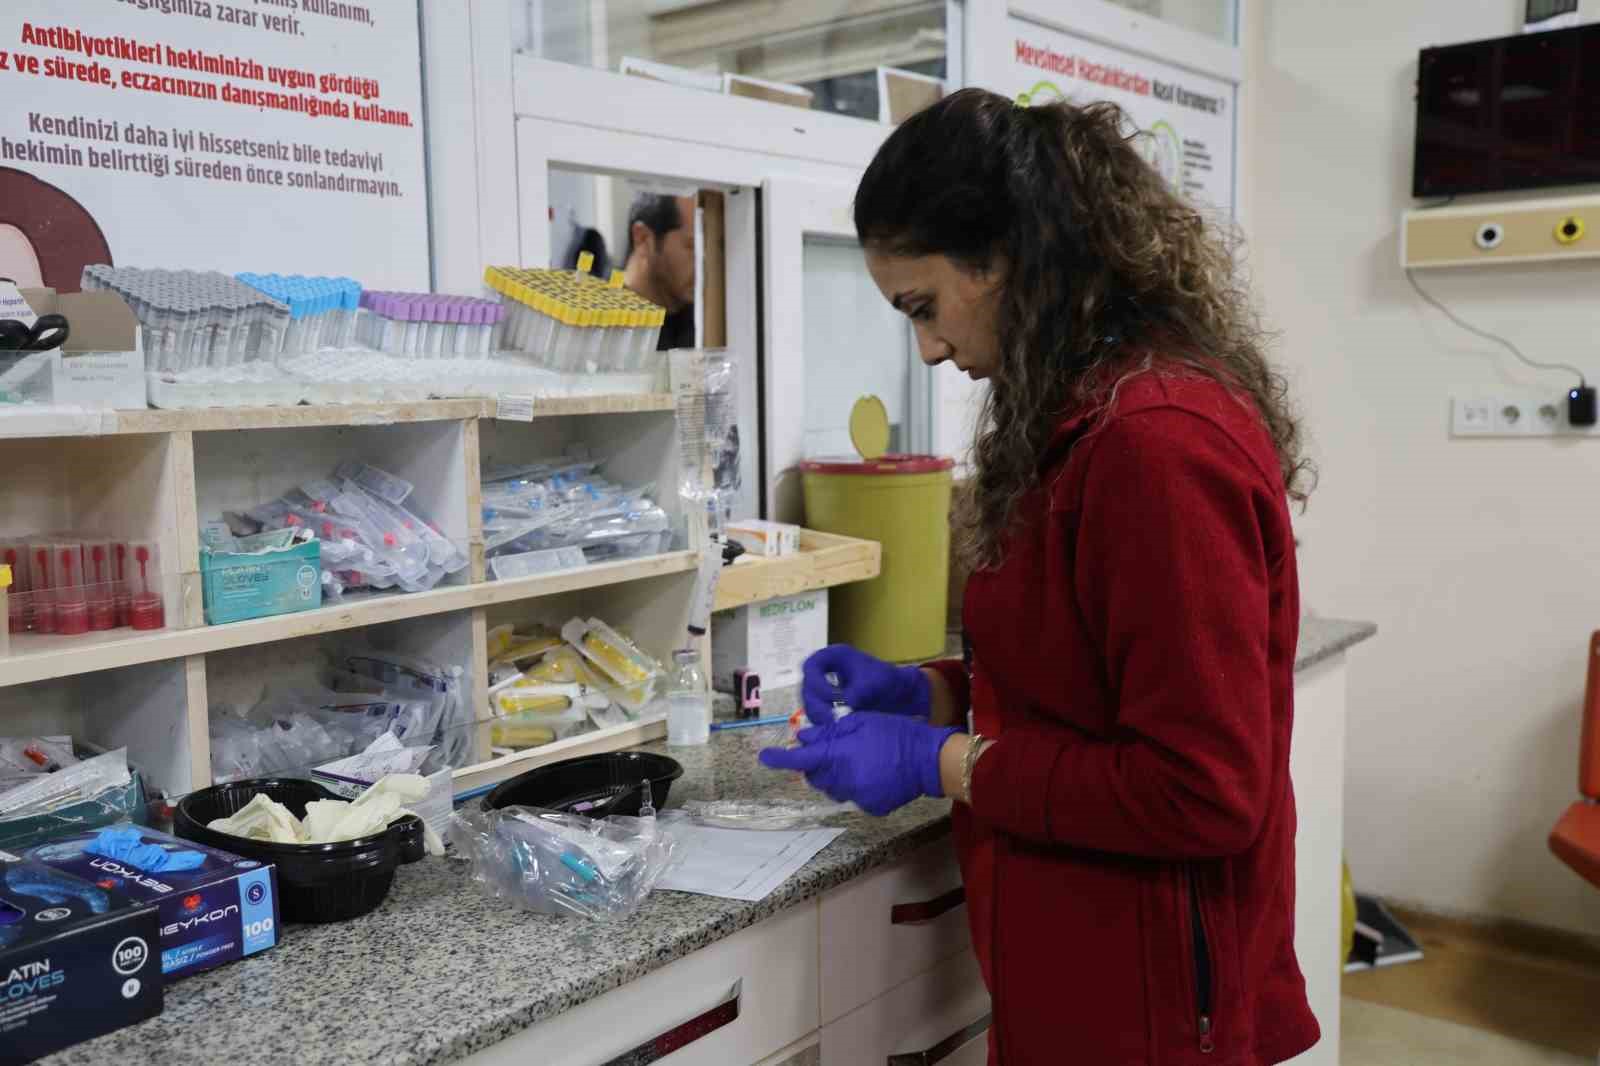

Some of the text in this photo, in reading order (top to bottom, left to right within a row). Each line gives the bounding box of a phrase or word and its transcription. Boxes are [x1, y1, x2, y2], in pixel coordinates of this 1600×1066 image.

[216, 4, 257, 28] zarar
[262, 13, 305, 36] verir.
[13, 53, 39, 75] ve
[44, 56, 117, 89] sürede,
[121, 70, 217, 100] eczacınızın
[221, 82, 349, 117] danışmanlığında
[353, 101, 413, 127] kullanın.
[21, 22, 380, 99] Antibiyotikleri hekiminizin uygun gördüğü
[1, 137, 403, 198] hekimin belirttiği süreden önce sonlandırmayın.
[28, 112, 383, 173] Kendinizi daha iyi hissetseniz bile tedaviyi
[118, 946, 142, 962] 100
[244, 917, 273, 938] 100
